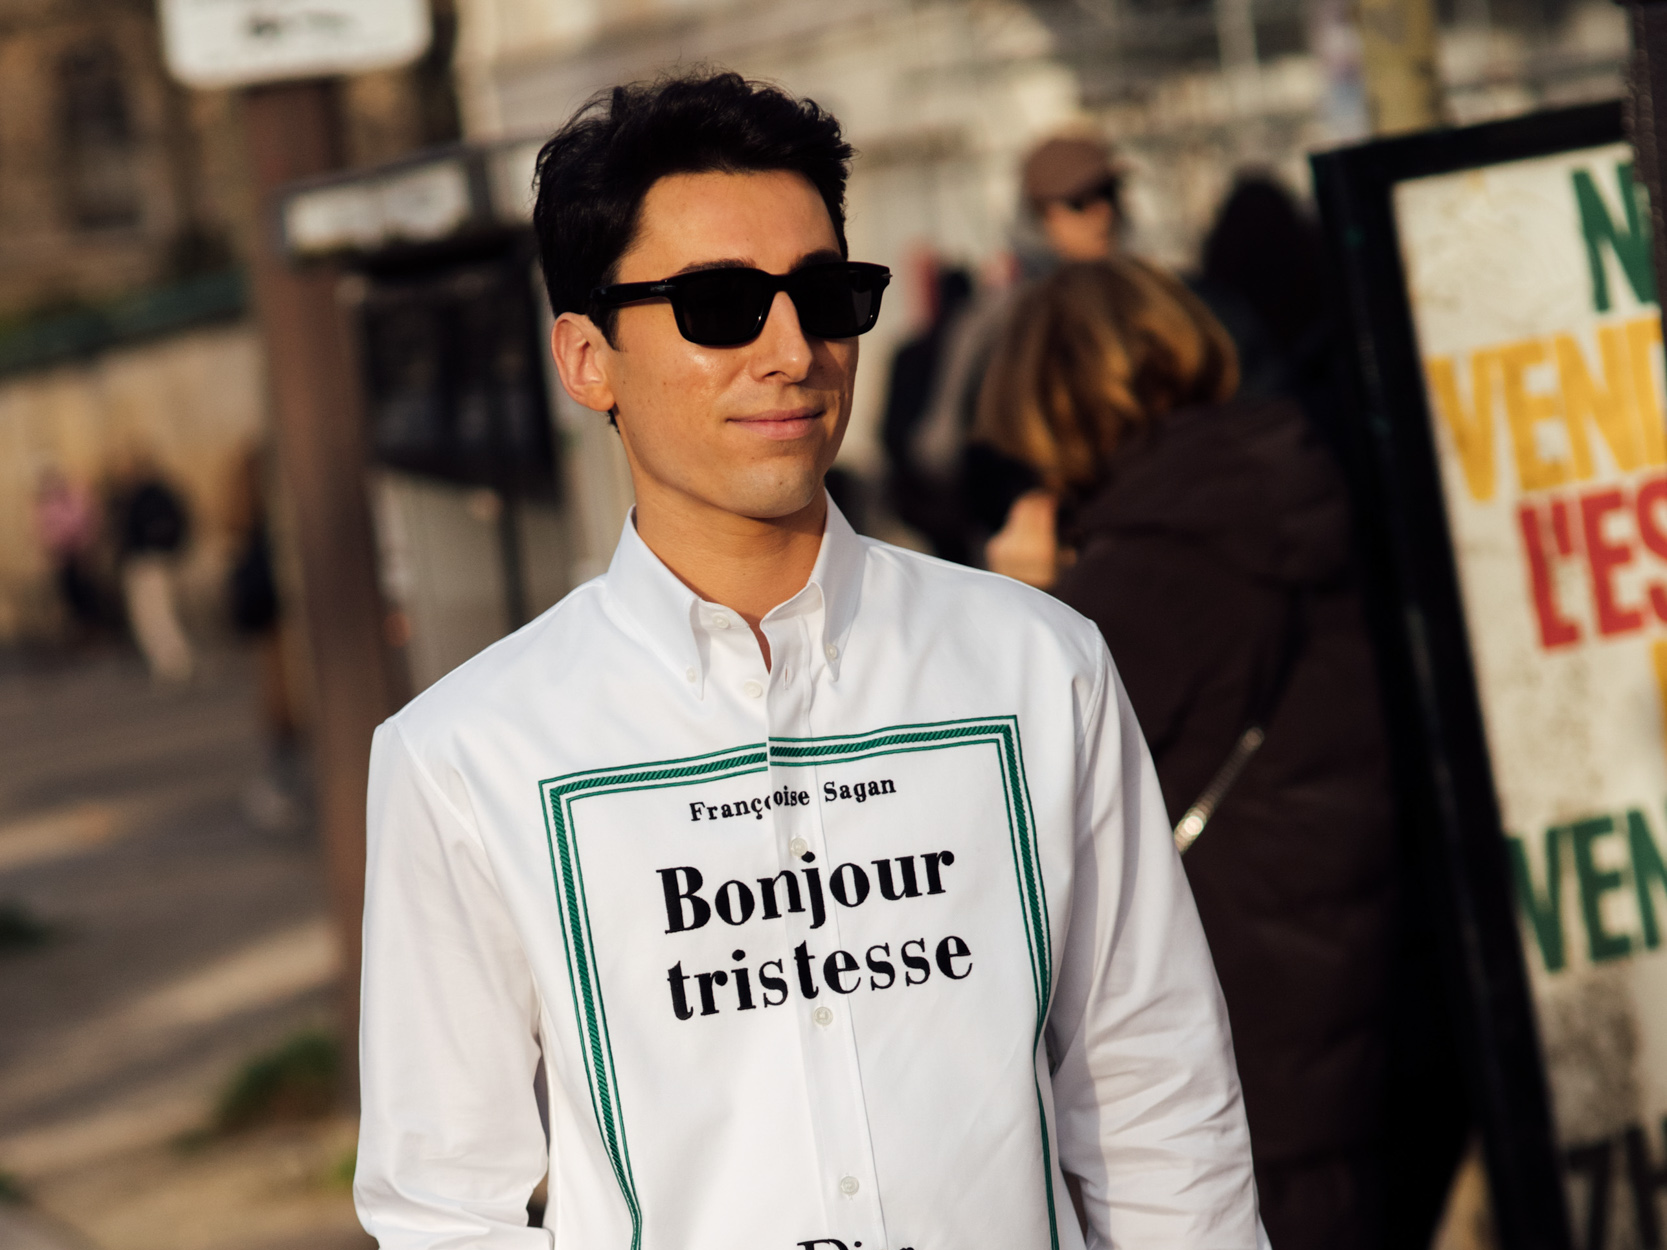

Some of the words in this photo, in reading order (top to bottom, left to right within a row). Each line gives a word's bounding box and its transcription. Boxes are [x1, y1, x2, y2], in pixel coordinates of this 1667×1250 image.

[690, 785, 810, 820] Françoise
[823, 779, 897, 803] Sagan
[656, 850, 955, 935] Bonjour
[667, 935, 973, 1021] tristesse
